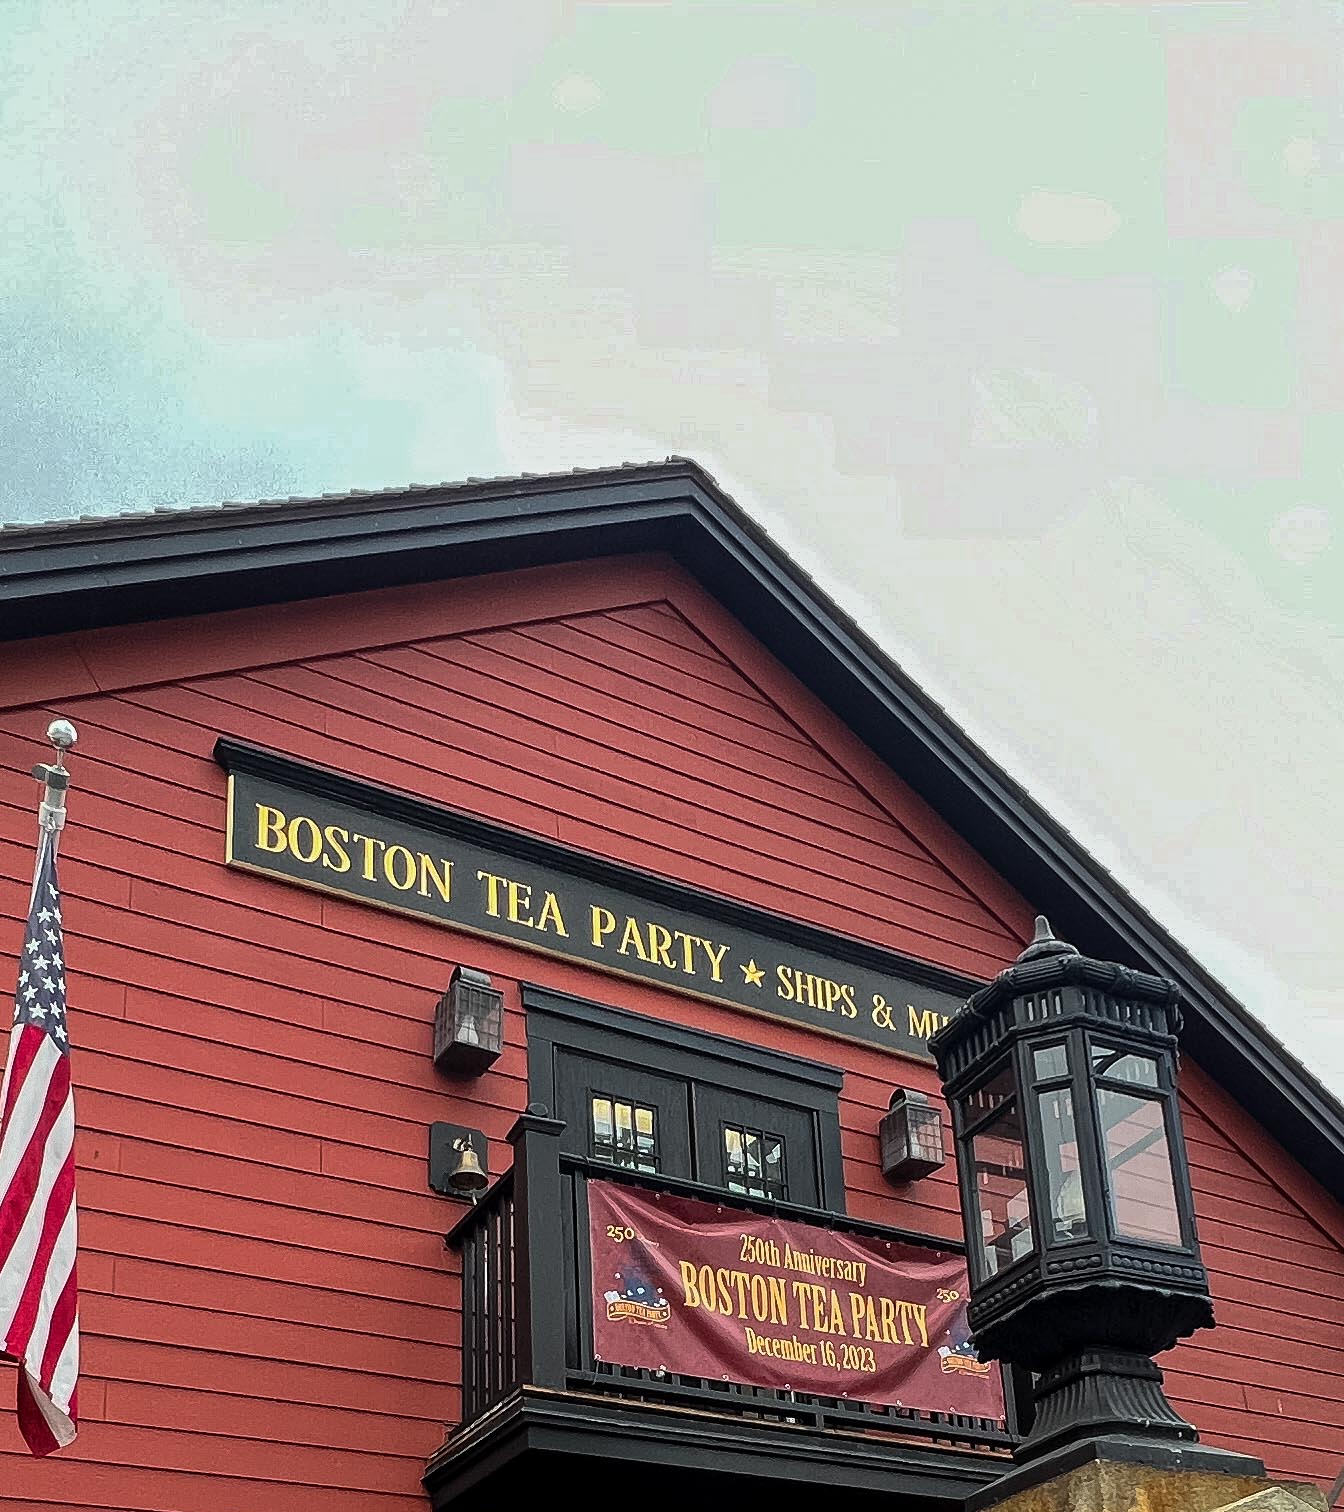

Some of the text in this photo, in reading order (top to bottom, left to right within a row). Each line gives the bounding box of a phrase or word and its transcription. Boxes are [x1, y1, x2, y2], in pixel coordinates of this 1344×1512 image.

[255, 802, 455, 903] BOSTON
[476, 870, 570, 938] TEA
[588, 903, 731, 985] PARTY
[777, 964, 859, 1018] SHIPS
[871, 994, 897, 1031] &
[606, 1225, 636, 1242] 250
[739, 1233, 868, 1288] 250th Anniversary
[678, 1258, 930, 1348] BOSTON TEA PARTY
[936, 1287, 960, 1303] 250
[745, 1327, 877, 1373] December 16, 2023
